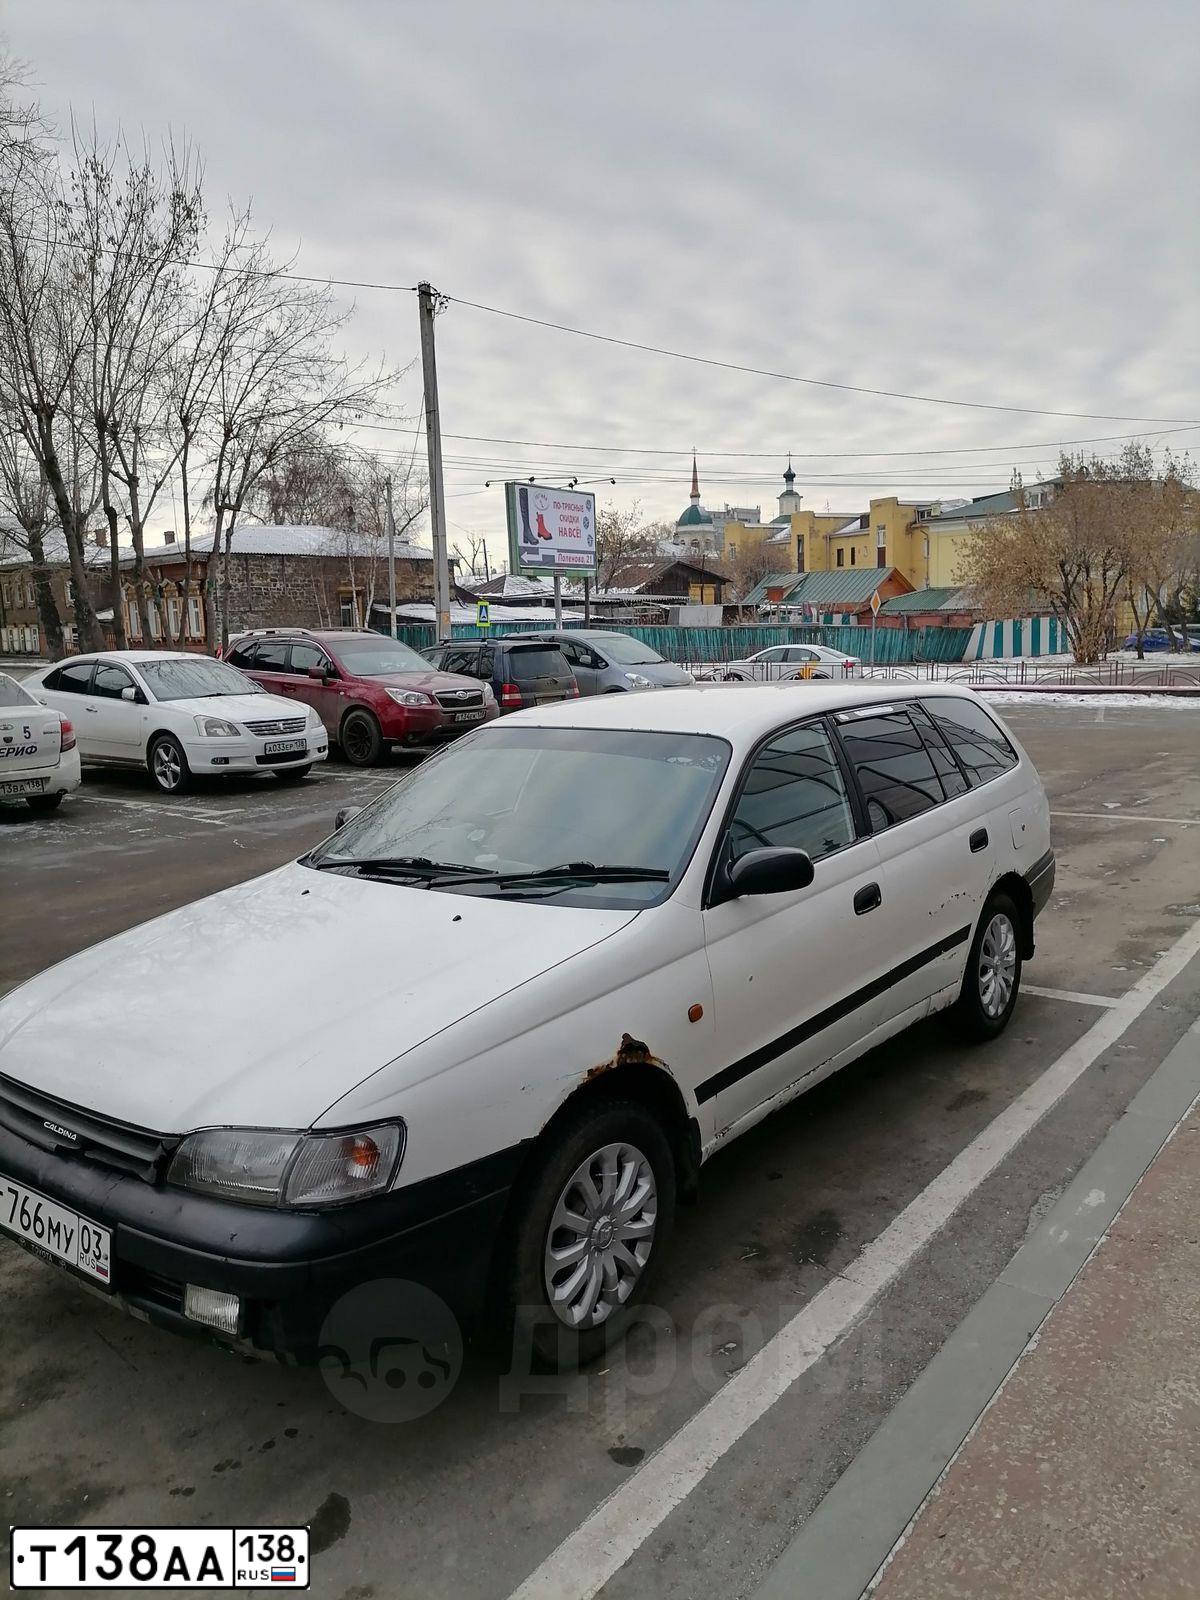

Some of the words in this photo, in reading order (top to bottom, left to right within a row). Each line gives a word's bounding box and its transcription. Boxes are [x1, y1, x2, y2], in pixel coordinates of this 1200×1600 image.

[553, 501, 584, 512] ПО-ТРЯСНЫЕ
[560, 514, 580, 524] СКИДКИ
[558, 527, 568, 537] НА
[586, 556, 592, 564] 21
[23, 726, 31, 739] 5
[43, 1121, 77, 1141] CALDINA
[81, 1224, 103, 1261] 03
[79, 1253, 96, 1270] RUS
